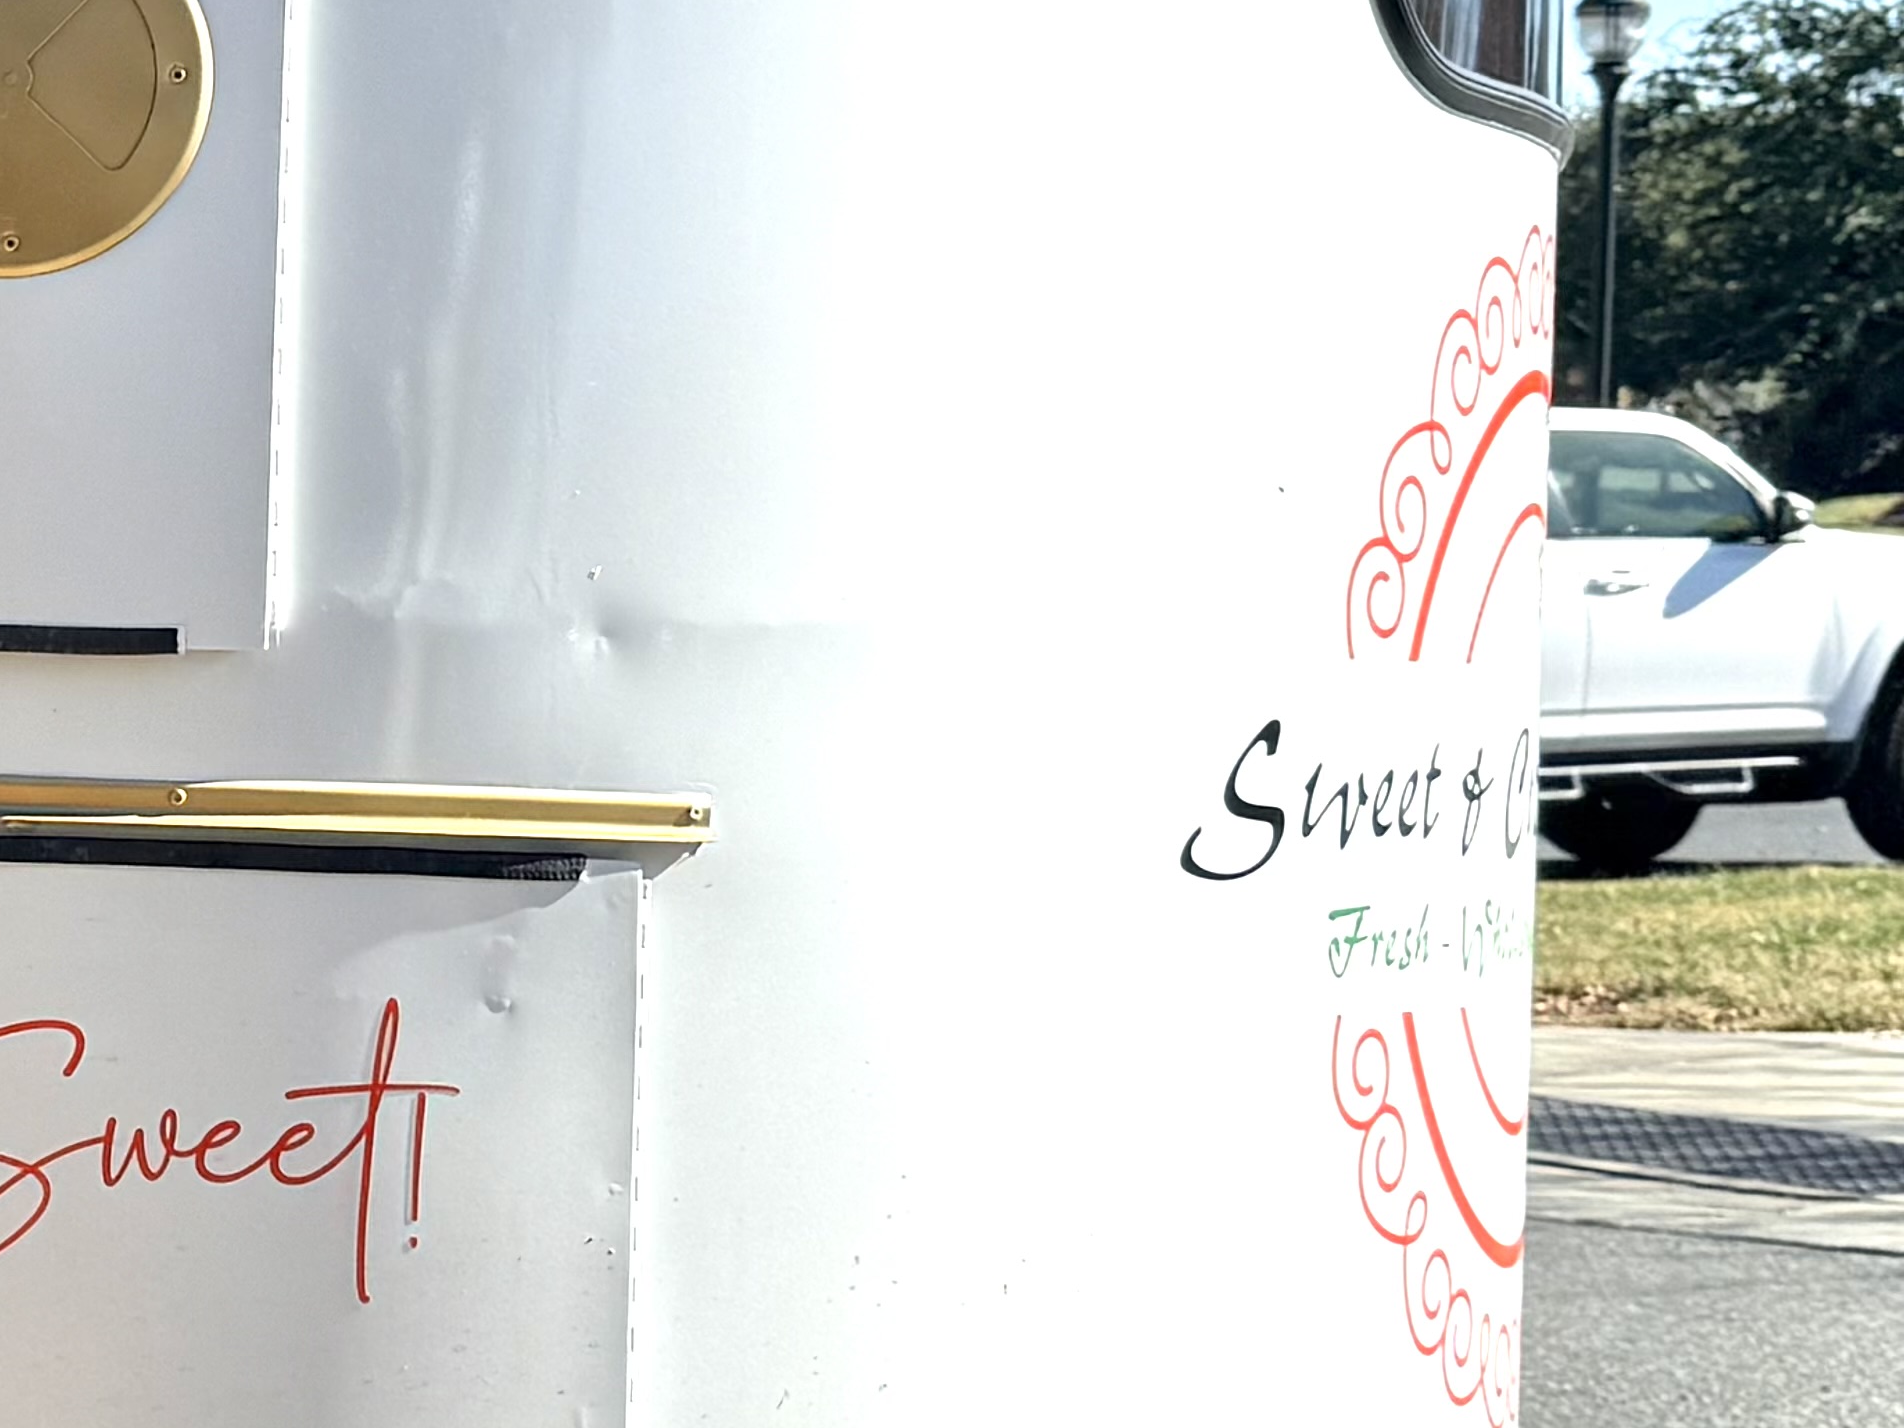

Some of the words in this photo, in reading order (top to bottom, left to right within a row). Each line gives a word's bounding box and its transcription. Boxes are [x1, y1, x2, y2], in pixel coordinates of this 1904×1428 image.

[1180, 719, 1442, 881] Sweet
[1462, 748, 1494, 857] &
[1328, 903, 1429, 978] Fresh
